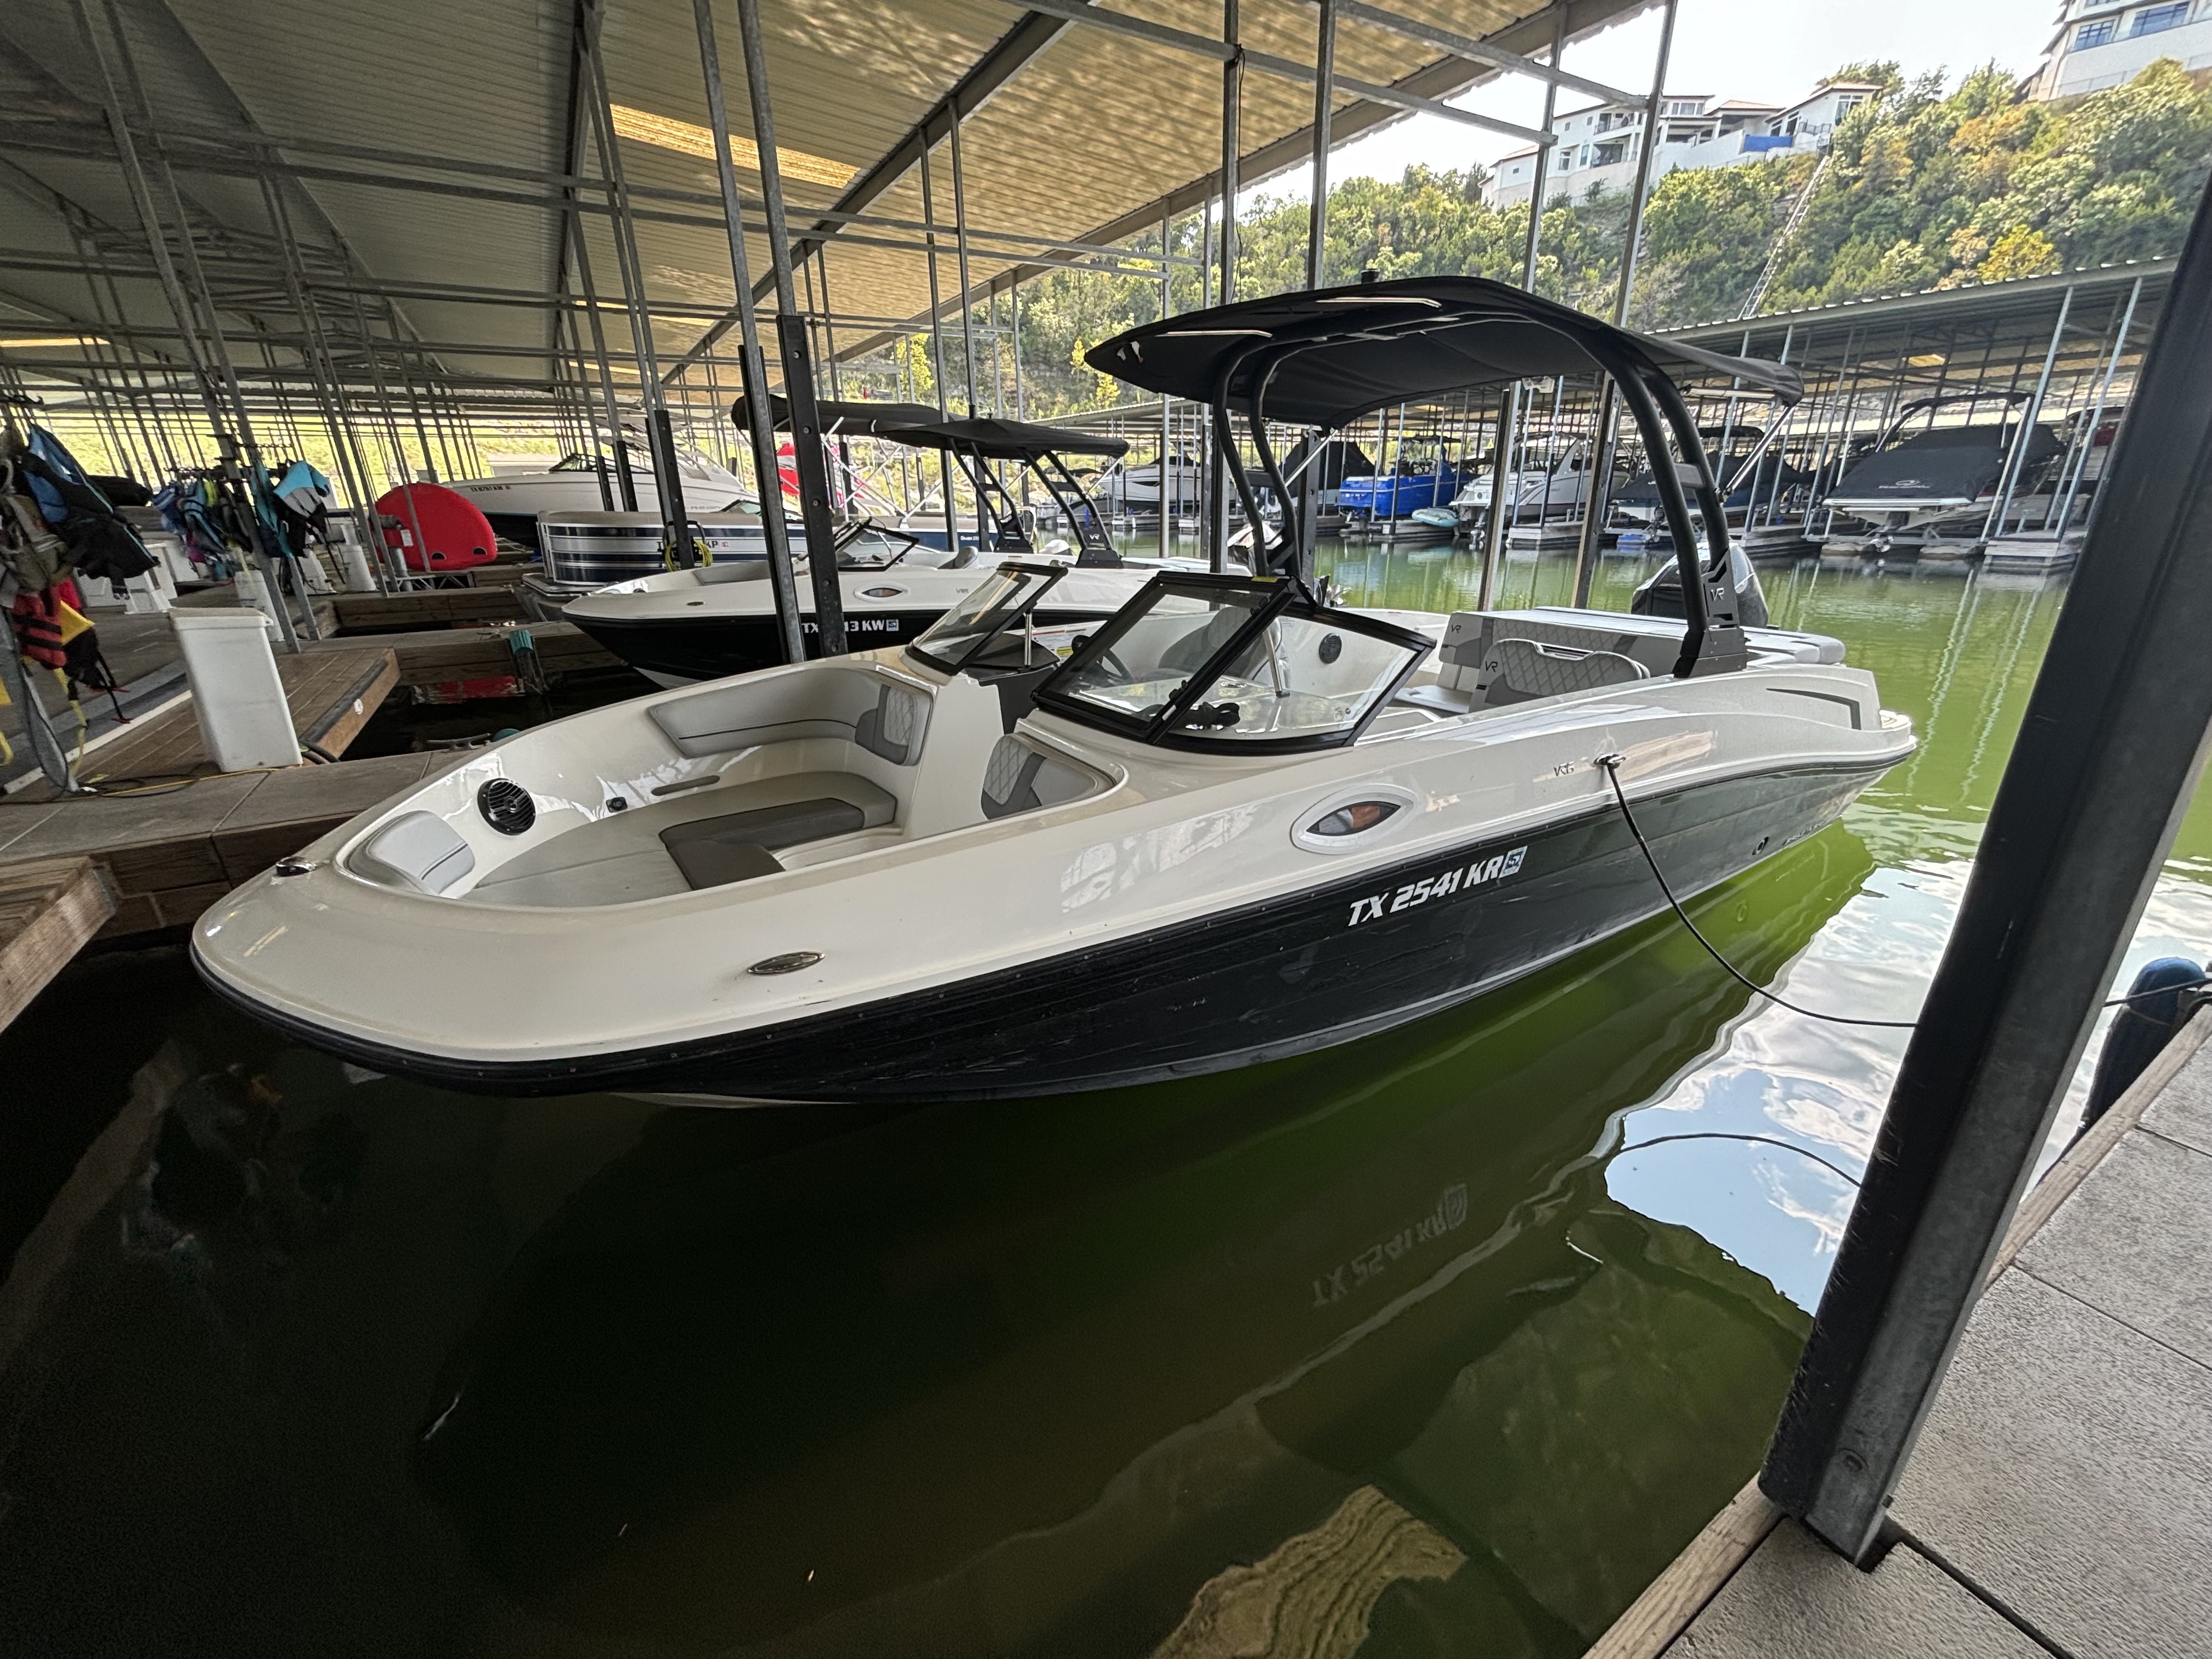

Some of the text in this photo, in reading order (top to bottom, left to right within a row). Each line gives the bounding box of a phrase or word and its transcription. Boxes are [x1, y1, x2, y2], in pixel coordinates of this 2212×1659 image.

[1710, 588, 1724, 601] VR
[802, 622, 819, 633] TX
[844, 620, 859, 631] 13
[862, 619, 884, 631] KW
[1451, 624, 1462, 634] VR
[1485, 661, 1498, 672] VR
[1348, 893, 1390, 927] TX
[1390, 868, 1463, 913] 2541
[1463, 855, 1504, 889] KR
